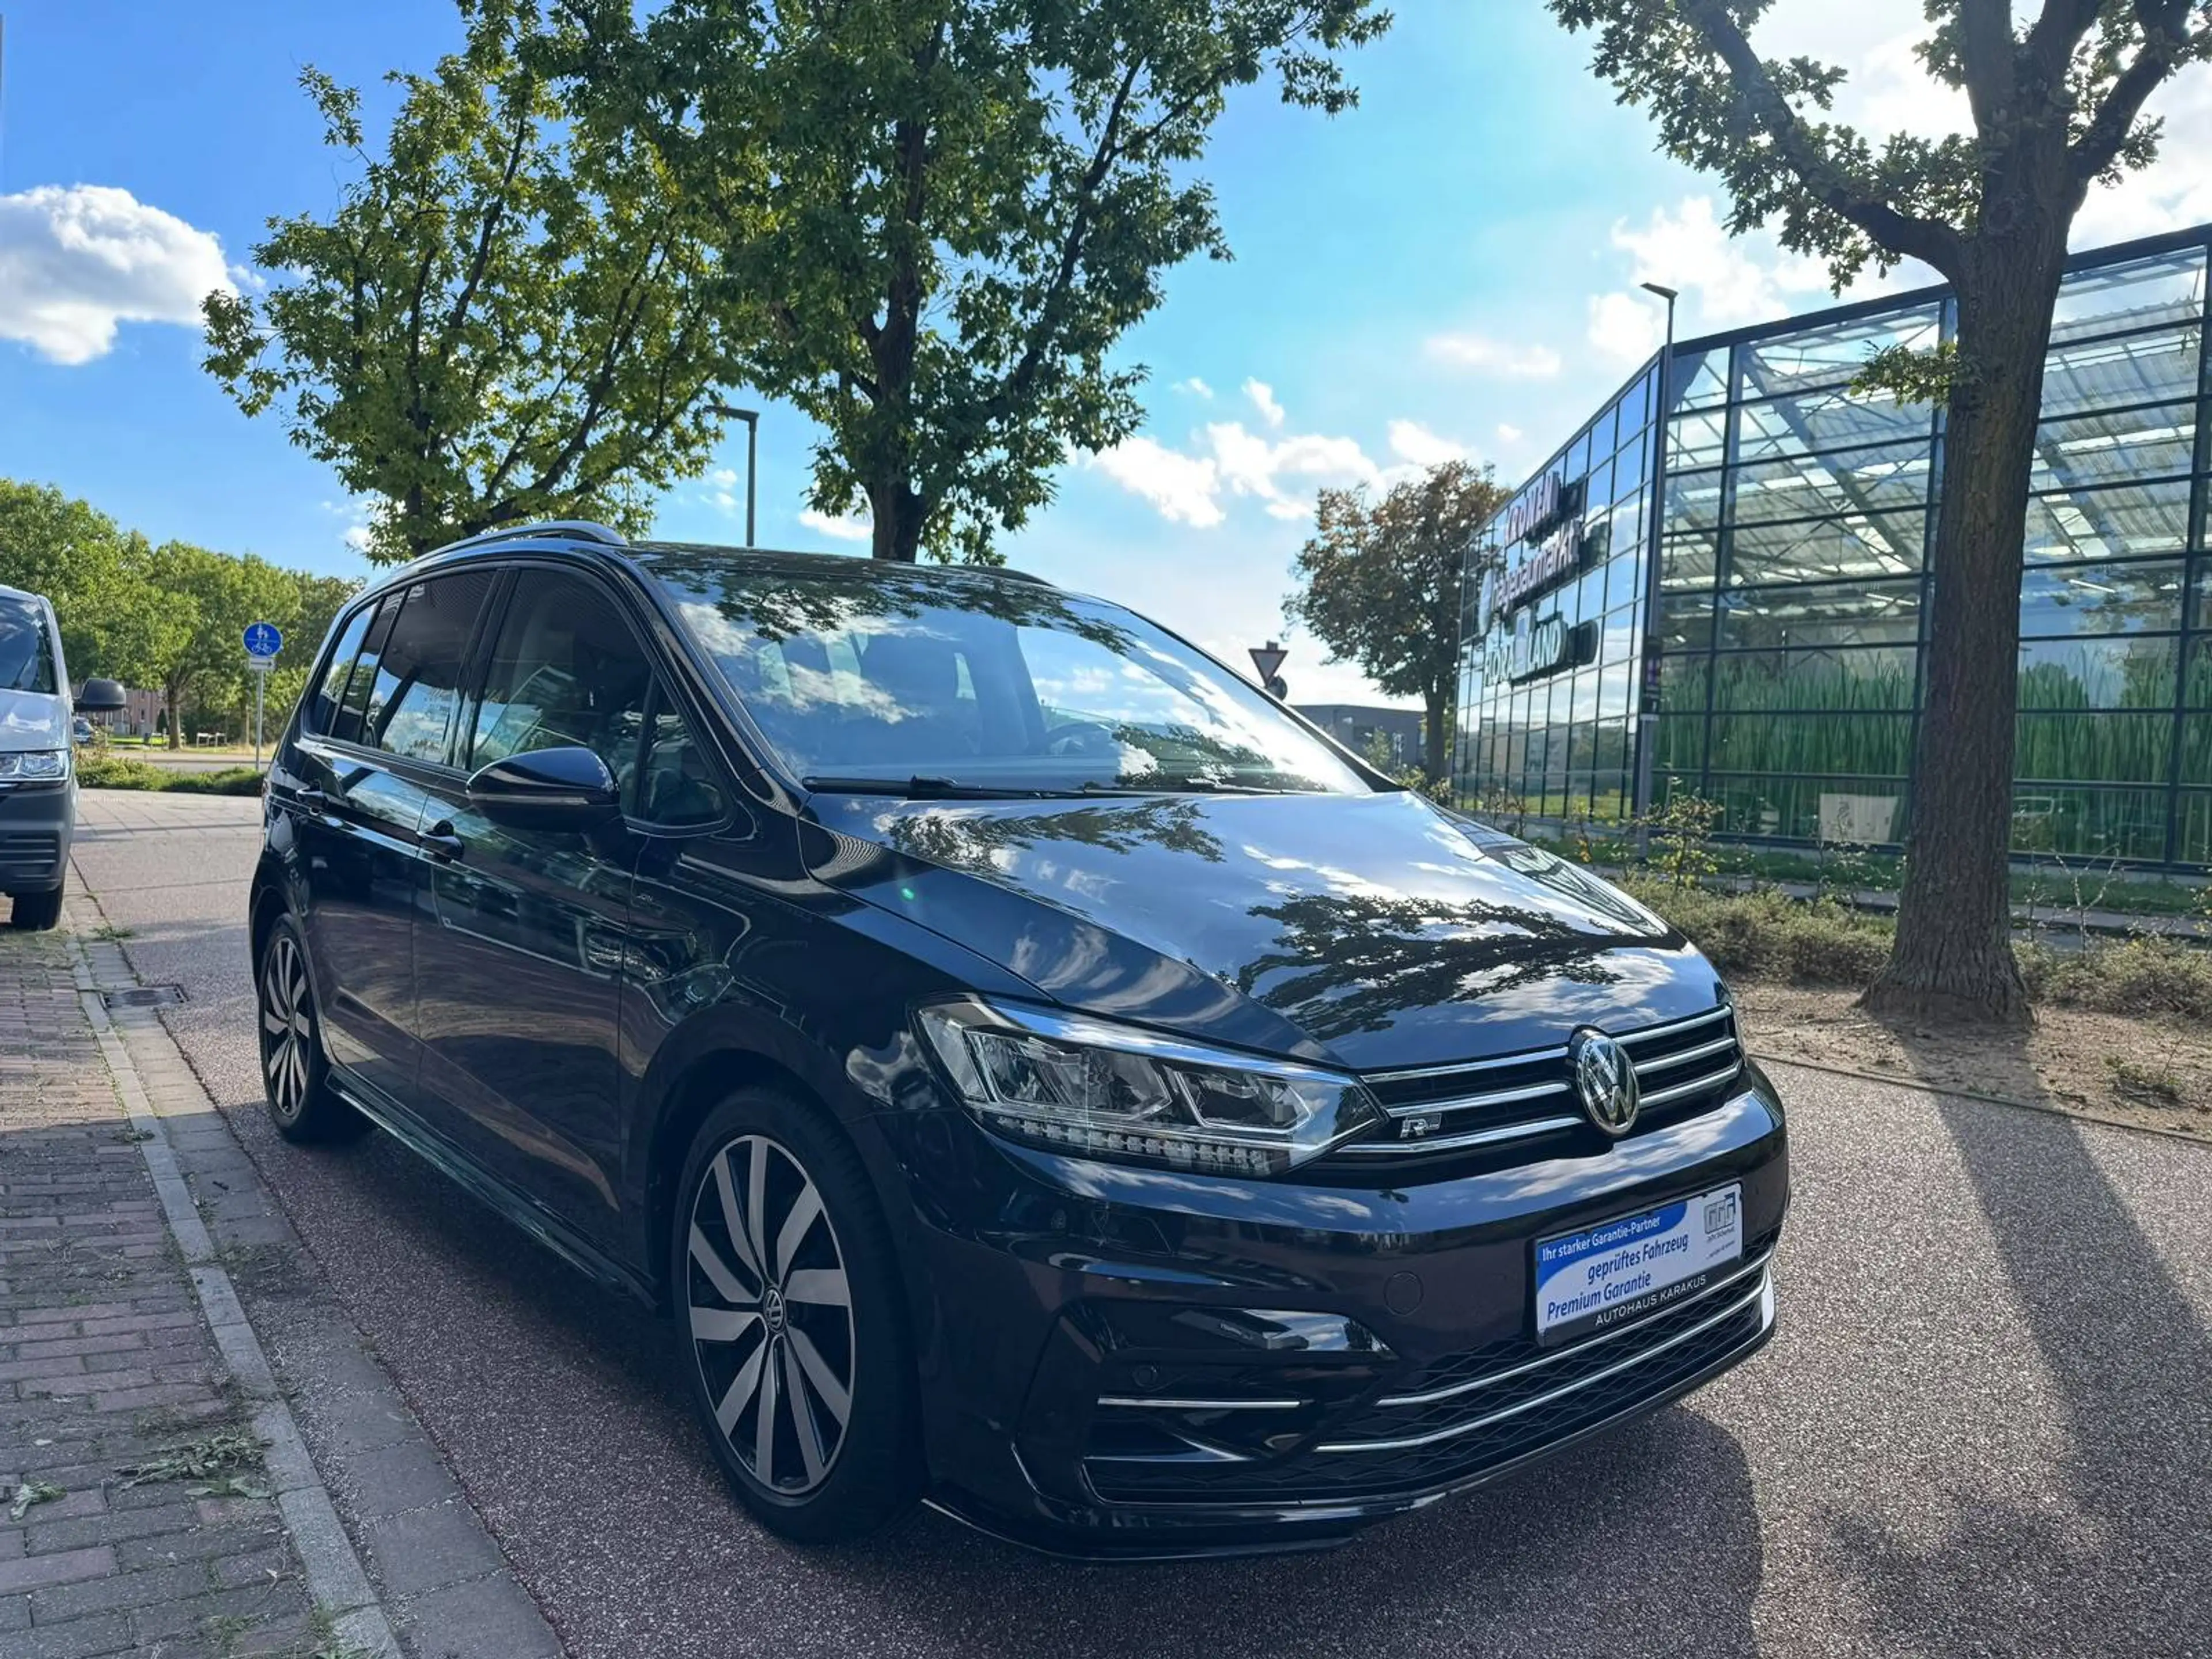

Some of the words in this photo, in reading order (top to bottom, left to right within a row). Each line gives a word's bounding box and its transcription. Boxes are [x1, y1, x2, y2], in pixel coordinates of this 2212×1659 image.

[1543, 1248, 1556, 1262] Ihr
[1558, 1238, 1590, 1257] starker
[1592, 1216, 1660, 1247] Garantie-Partner
[1588, 1249, 1641, 1285] geprüftes
[1643, 1233, 1688, 1262] Fahrzeug
[1547, 1290, 1601, 1321] Premium
[1604, 1270, 1651, 1301] Garantie
[1595, 1295, 1657, 1327] AUTOHAUS
[1660, 1274, 1706, 1303] KARAKUS
